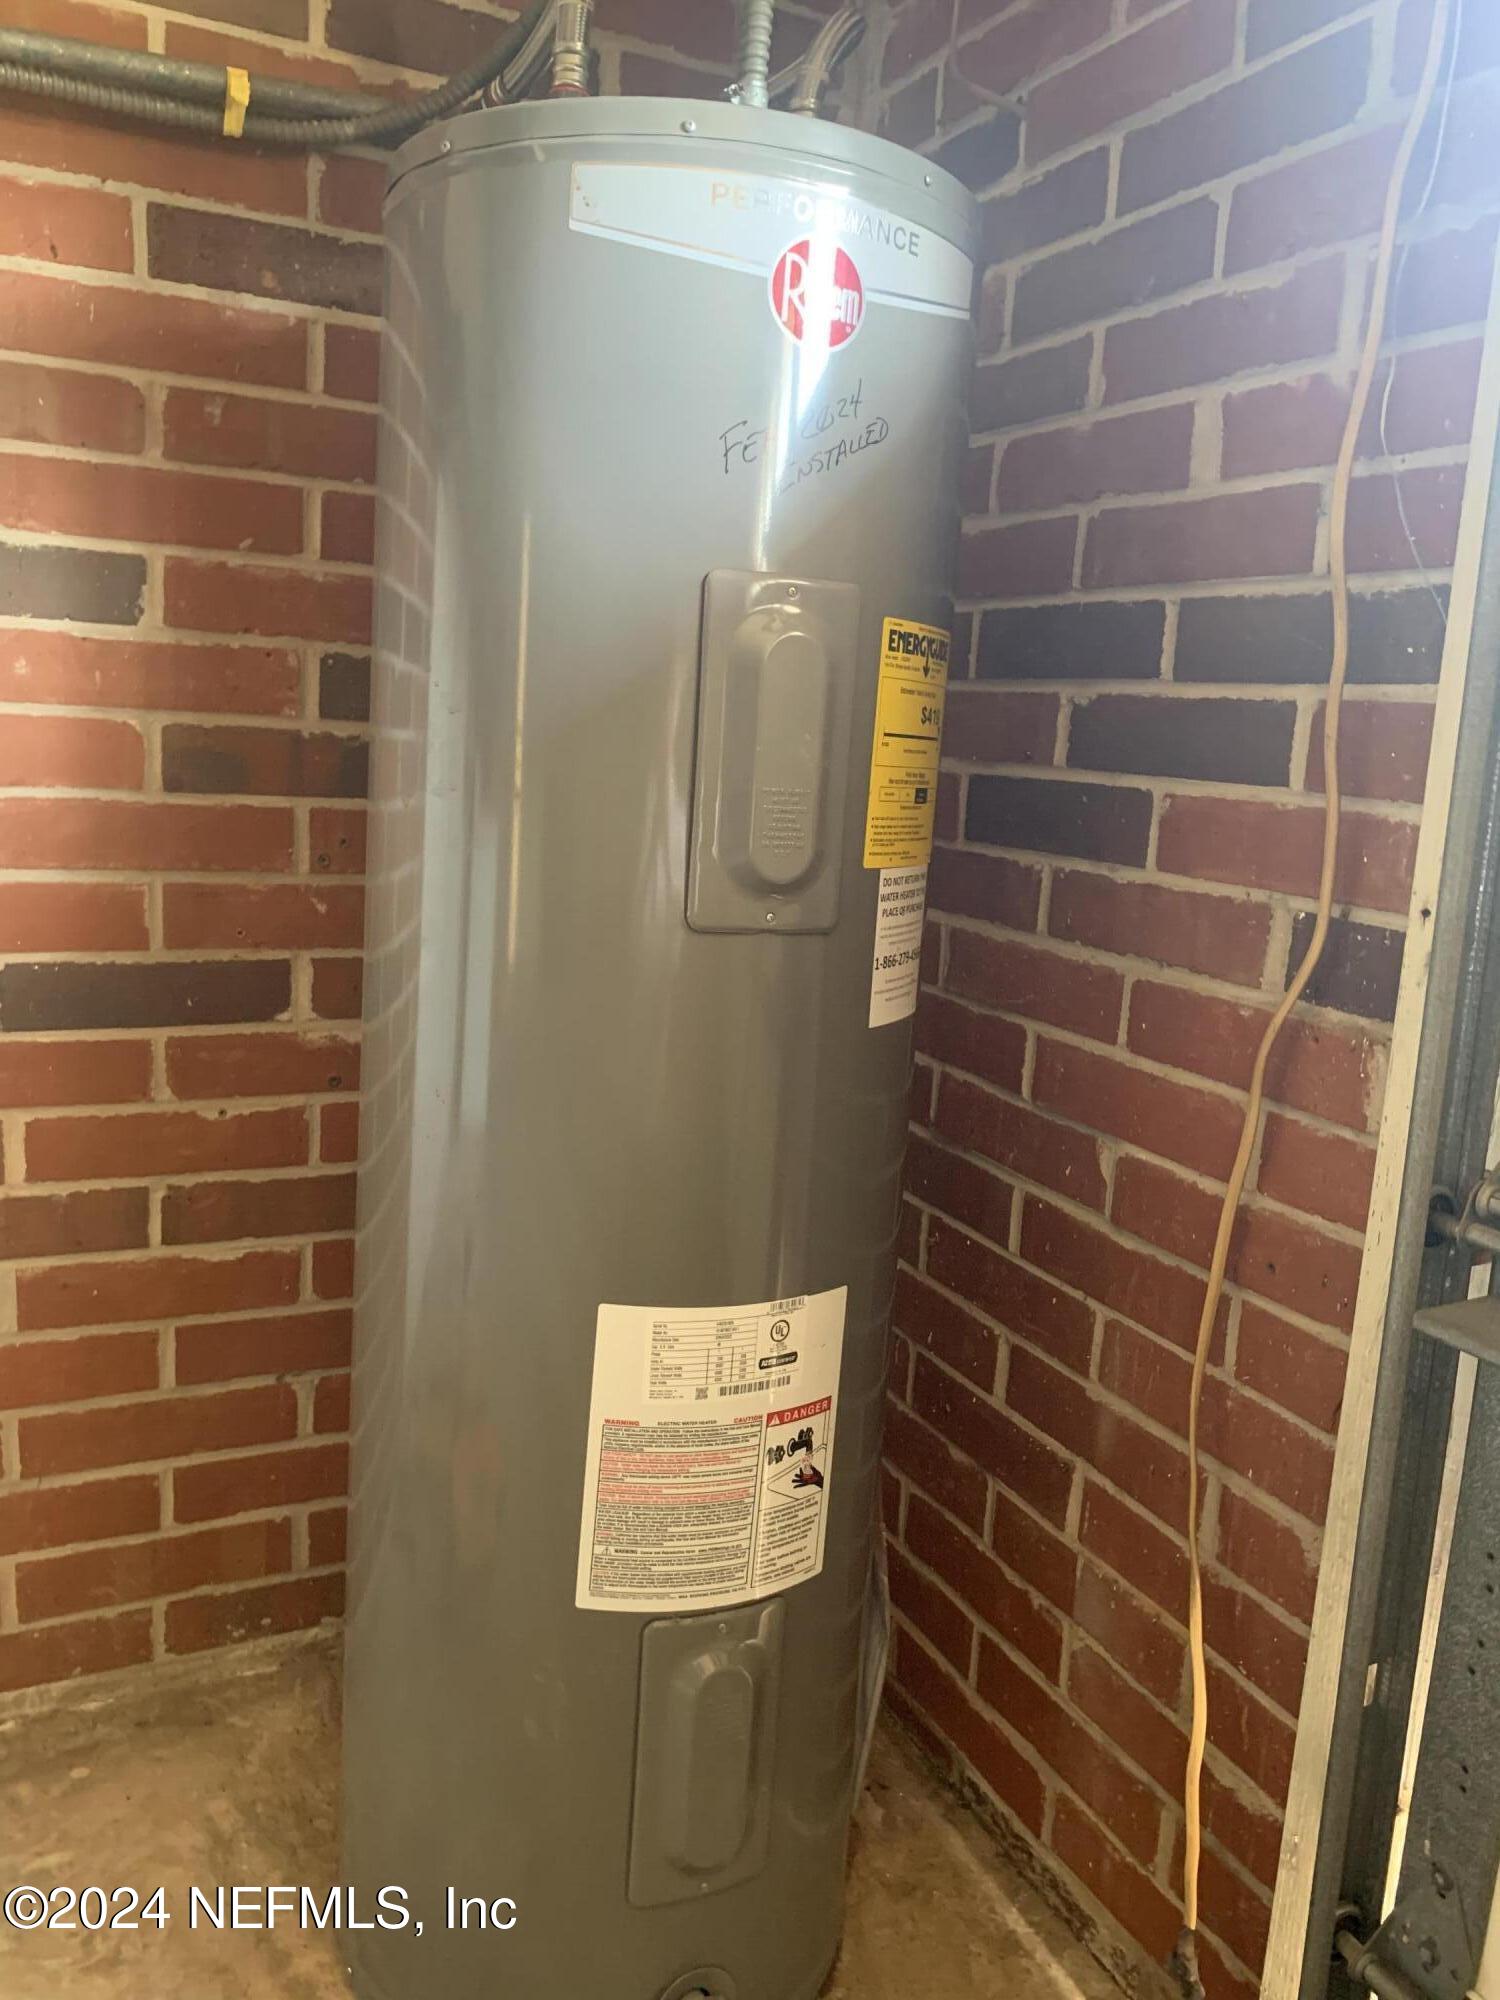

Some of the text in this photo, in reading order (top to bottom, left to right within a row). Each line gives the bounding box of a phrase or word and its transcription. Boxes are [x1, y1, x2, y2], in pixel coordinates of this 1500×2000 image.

[710, 182, 921, 258] PERFOMANCE
[781, 250, 860, 328] Rem
[719, 419, 768, 475] FE
[883, 878, 892, 887] DO
[893, 876, 904, 886] NOT
[880, 892, 899, 902] WATER
[882, 907, 899, 917] PLACE
[784, 1400, 828, 1422] DANGER
[604, 1418, 640, 1427] WARNING
[733, 1414, 763, 1424] CAUTION
